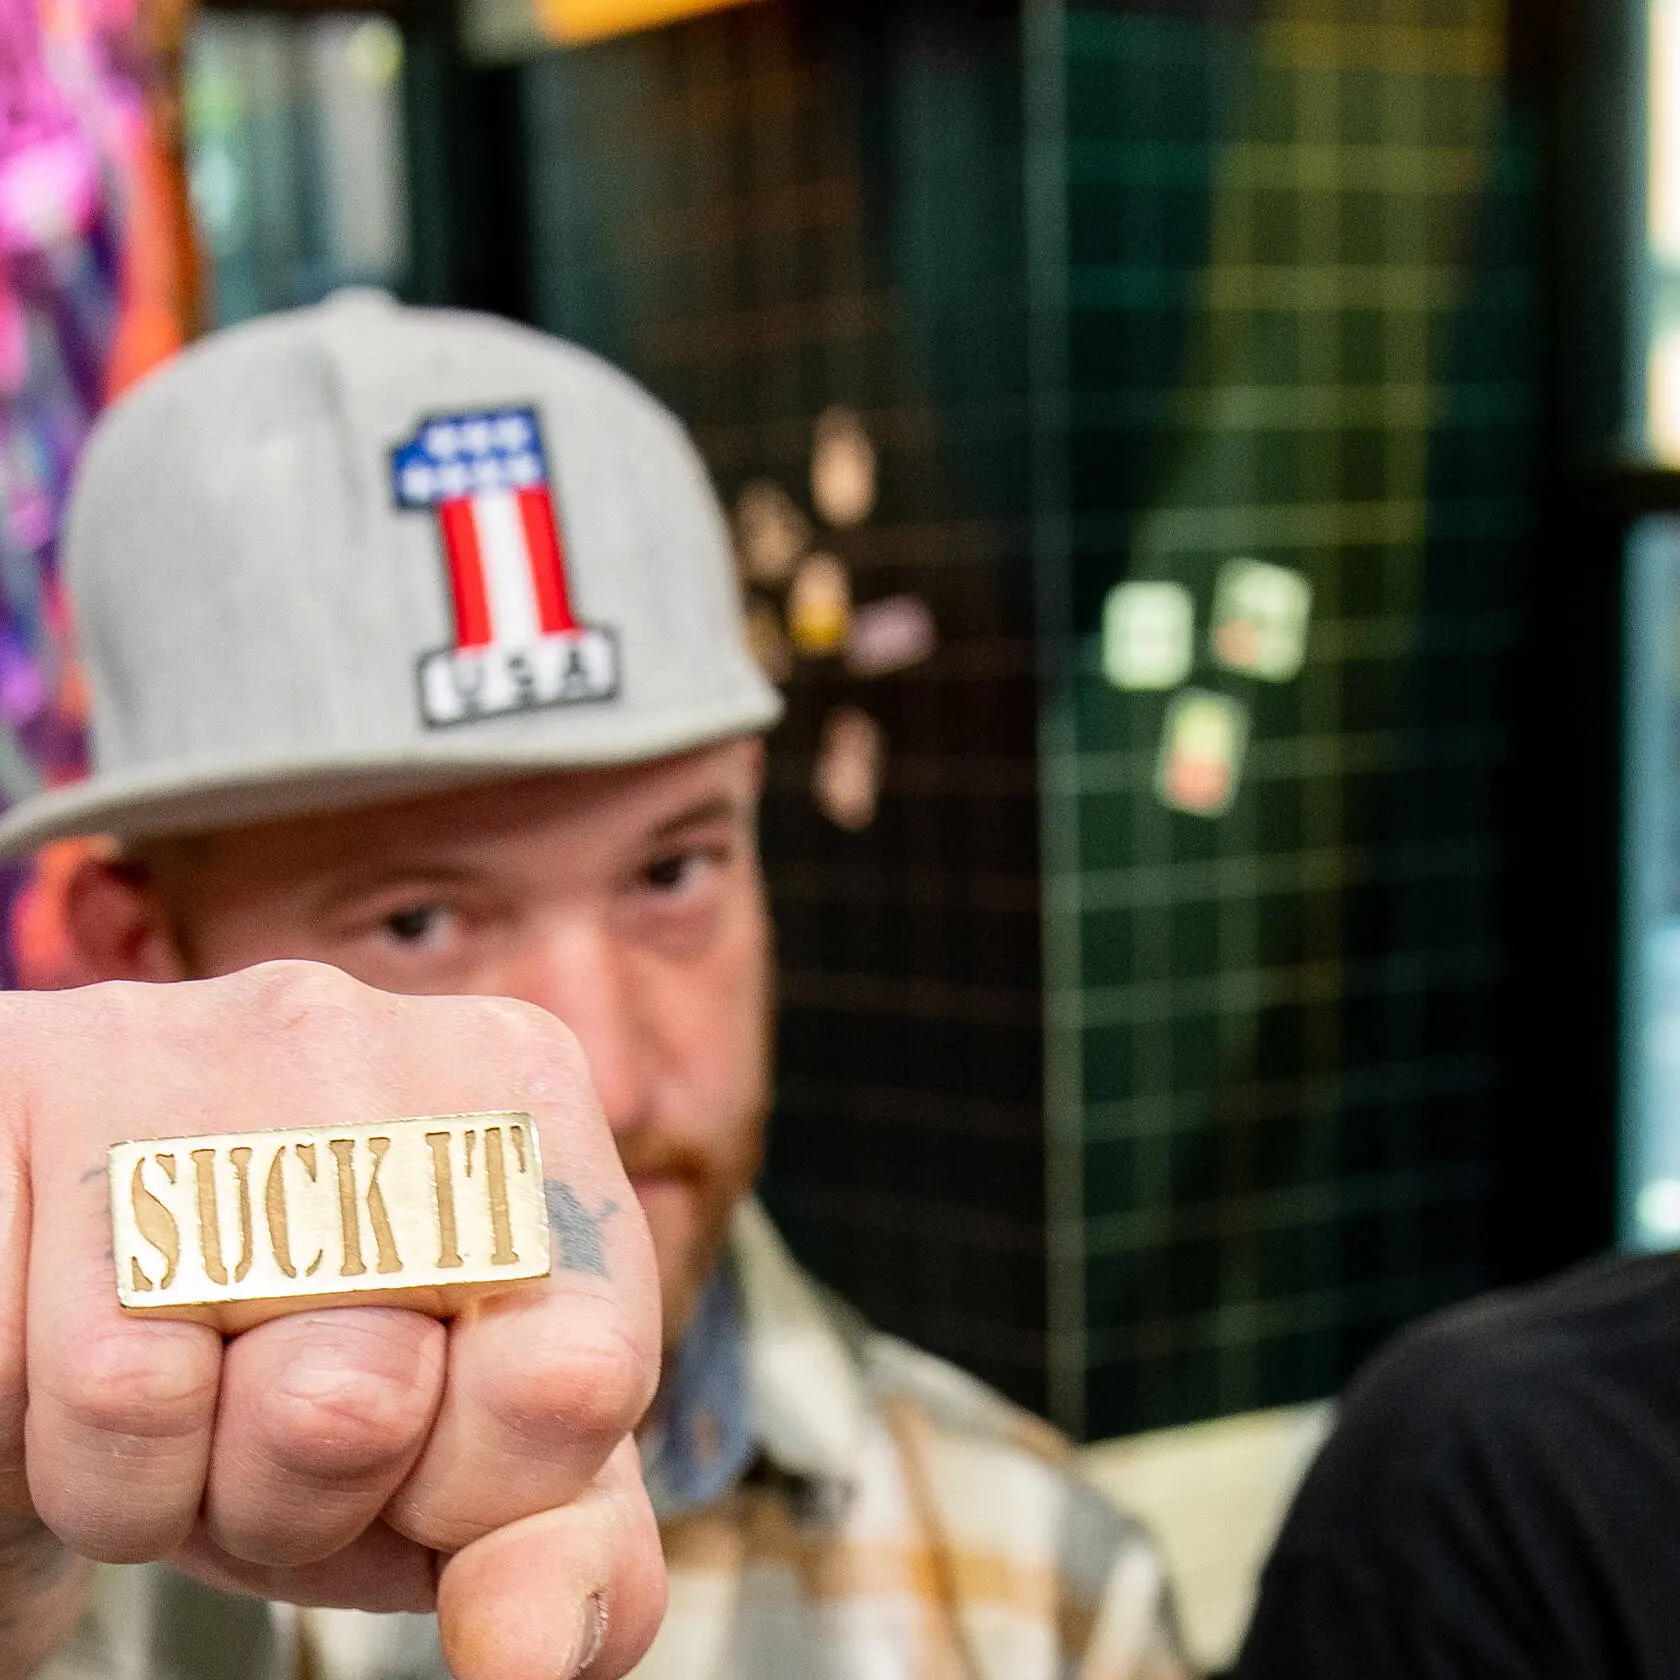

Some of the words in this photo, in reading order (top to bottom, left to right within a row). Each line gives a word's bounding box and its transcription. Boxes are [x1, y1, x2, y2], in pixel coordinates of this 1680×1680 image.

[422, 628, 617, 724] USA
[129, 1135, 405, 1292] SUCK
[424, 1124, 528, 1270] IT
